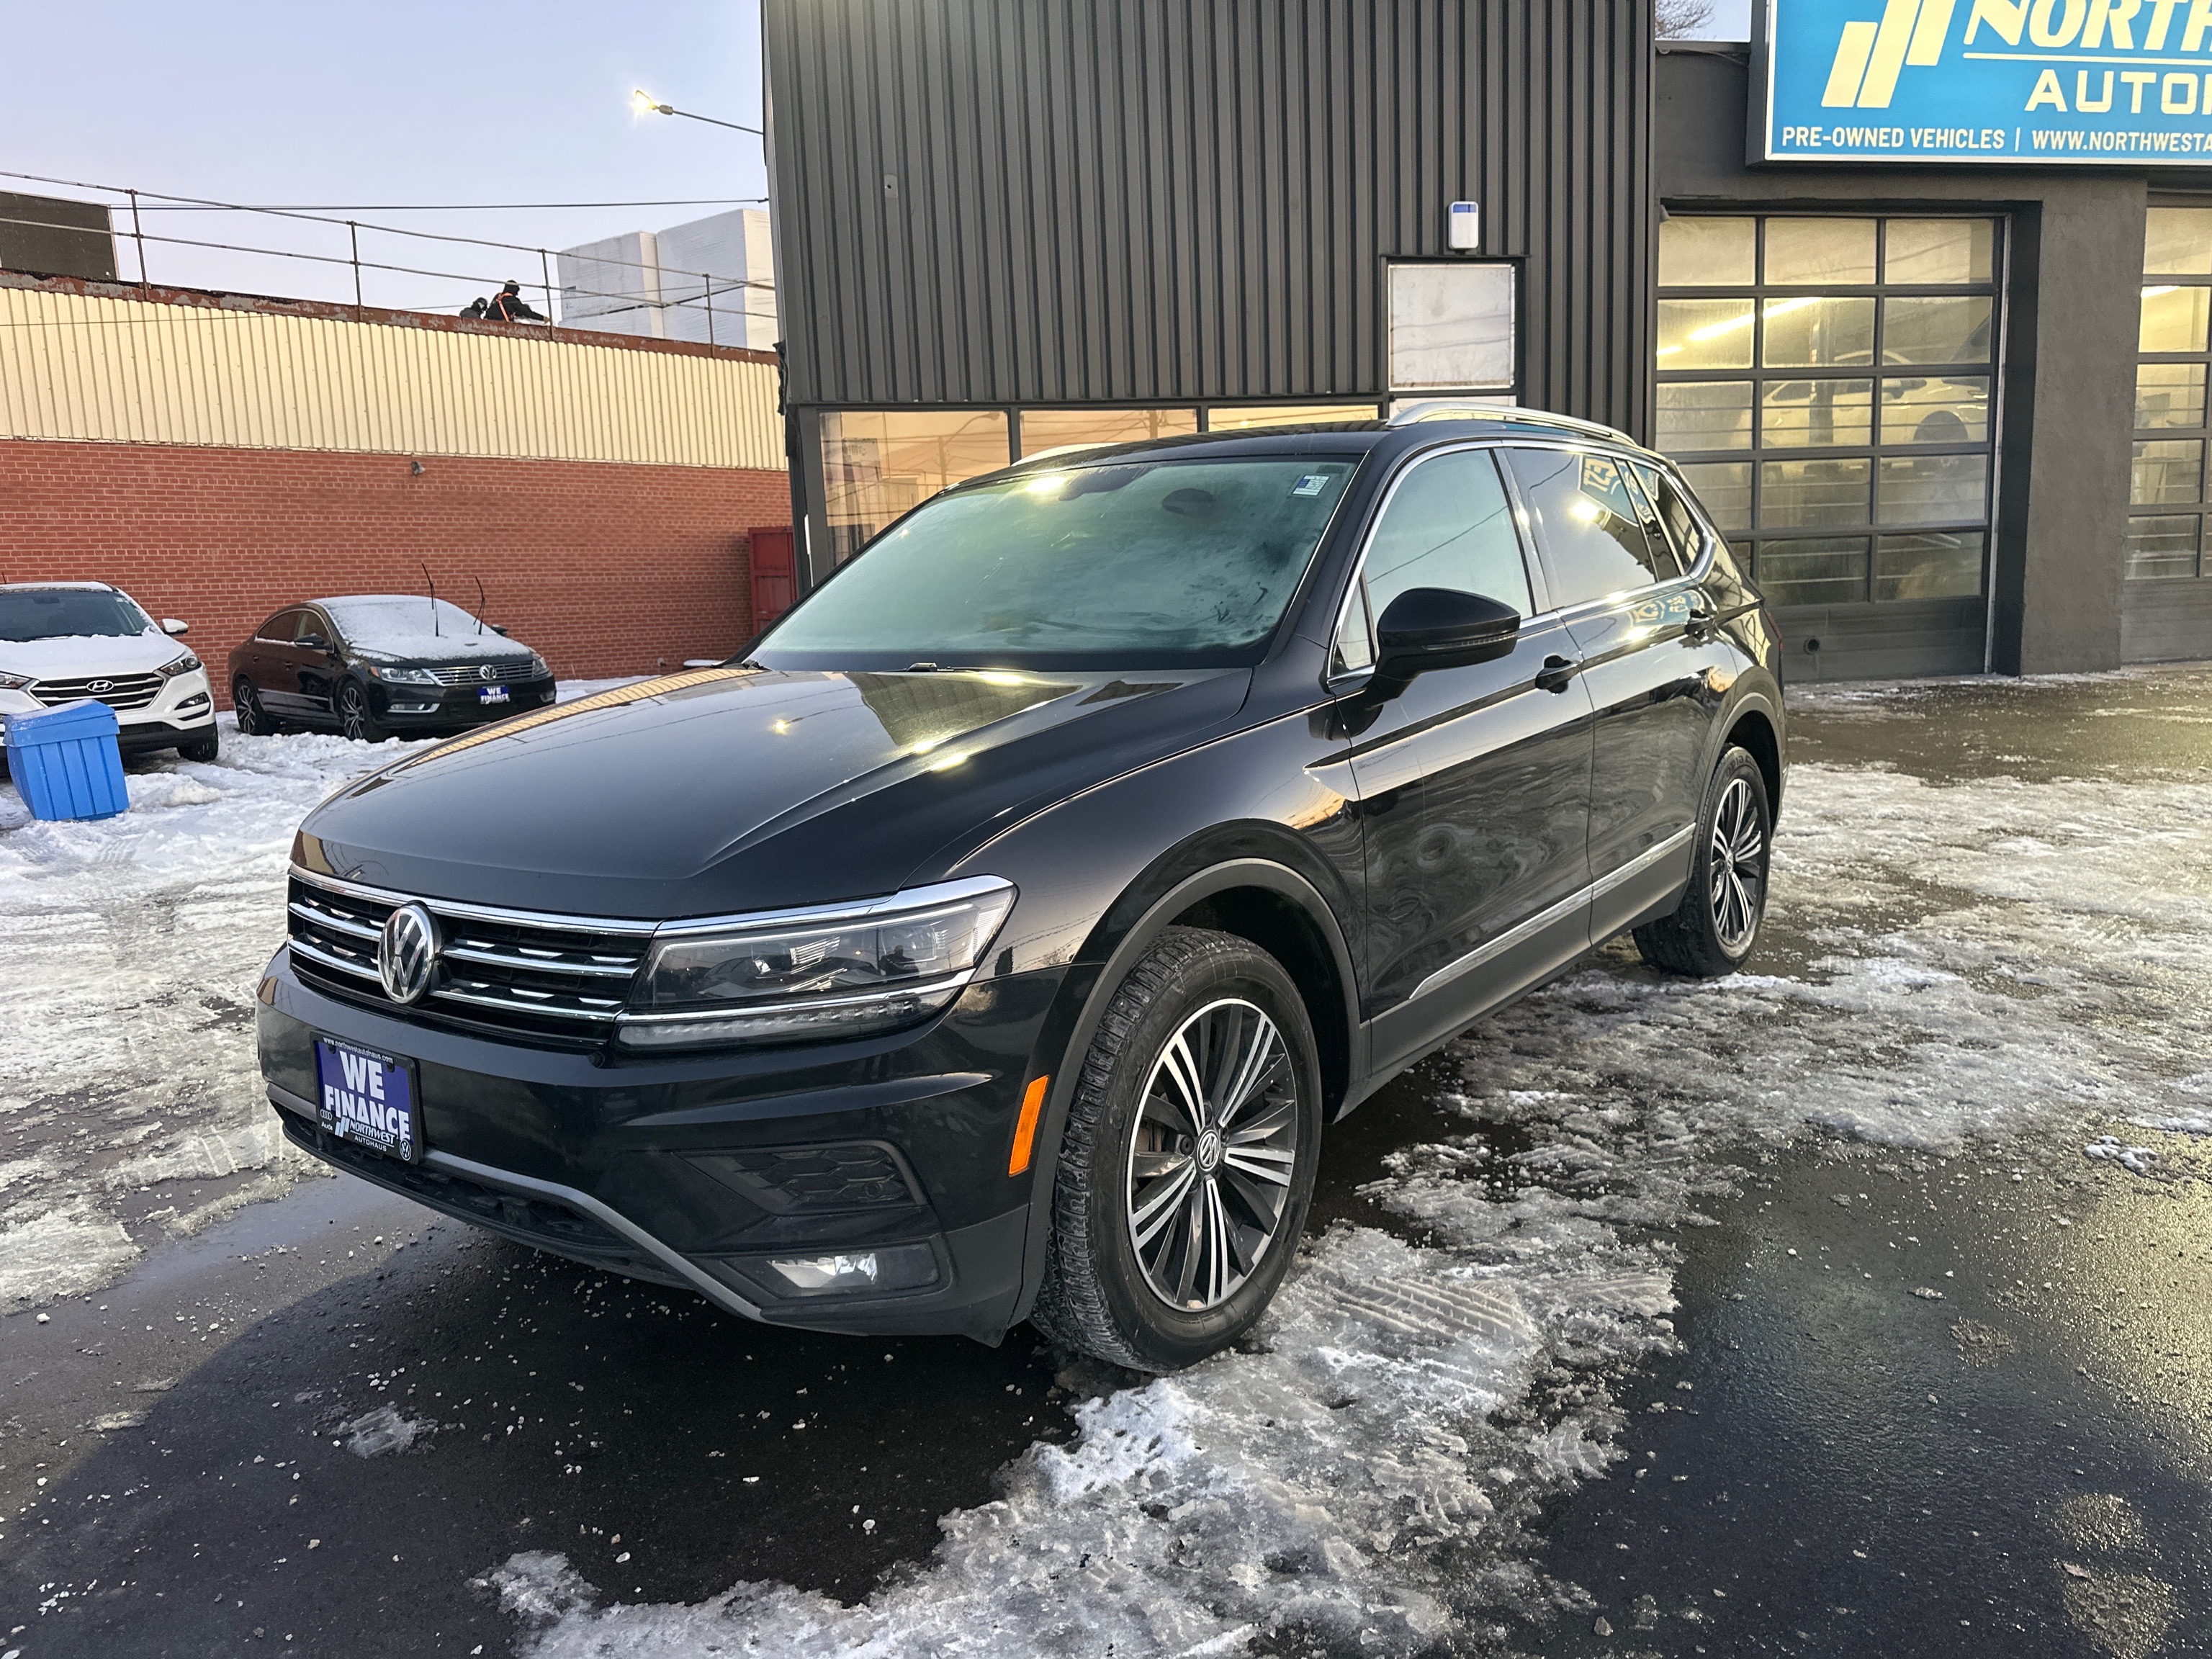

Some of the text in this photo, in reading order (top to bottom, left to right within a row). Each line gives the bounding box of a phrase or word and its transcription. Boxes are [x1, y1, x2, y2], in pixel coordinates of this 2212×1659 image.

[2024, 68, 2212, 115] AUTO
[1781, 126, 1905, 148] PRE-OWNED
[1910, 127, 2006, 149] VEHICLES
[480, 693, 510, 703] FINANCE
[323, 1037, 394, 1064] www.northwestautohaus.com
[339, 1050, 385, 1100] WE
[324, 1084, 410, 1141] FINANCE
[349, 1119, 395, 1144] NORTHWEST
[354, 1134, 387, 1152] AUTOHAUS
